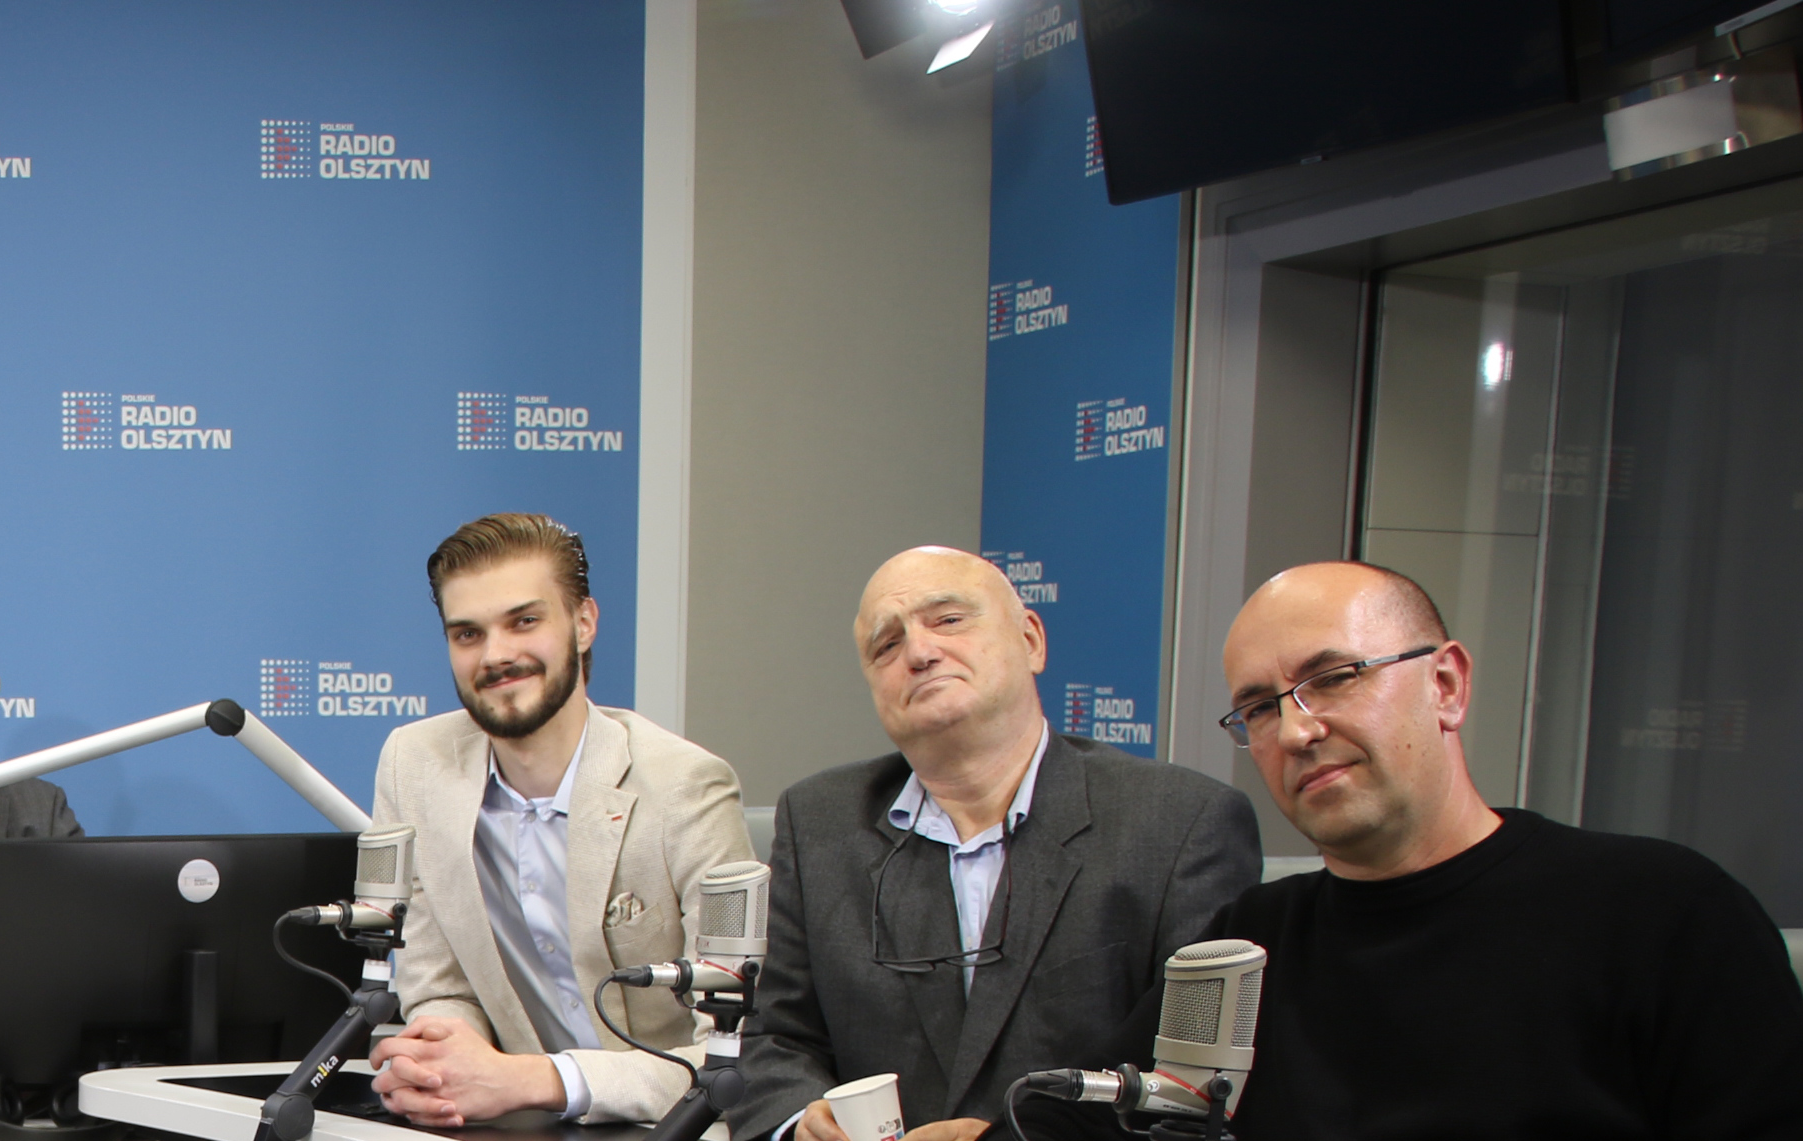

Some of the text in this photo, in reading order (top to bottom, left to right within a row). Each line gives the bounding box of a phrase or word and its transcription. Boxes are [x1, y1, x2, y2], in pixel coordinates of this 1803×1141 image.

[1023, 20, 1077, 60] OLSZTYN
[320, 134, 395, 155] RADIO
[320, 158, 429, 179] OLSZTYN
[1016, 286, 1052, 312] RADIO
[1015, 304, 1068, 335] OLSZTYN
[122, 406, 196, 425] RADIO
[516, 407, 588, 427] RADIO
[1105, 405, 1147, 432] RADIO
[121, 429, 231, 449] OLSZTYN
[515, 430, 622, 450] OLSZTYN
[1105, 426, 1165, 456] OLSZTYN
[1007, 561, 1043, 582] RADIO
[1015, 582, 1058, 604] SZTYN
[319, 673, 392, 692] RADIO
[318, 696, 426, 715] OLSZTYN
[1094, 698, 1135, 719] RADIO
[1093, 722, 1152, 744] OLSZTYN
